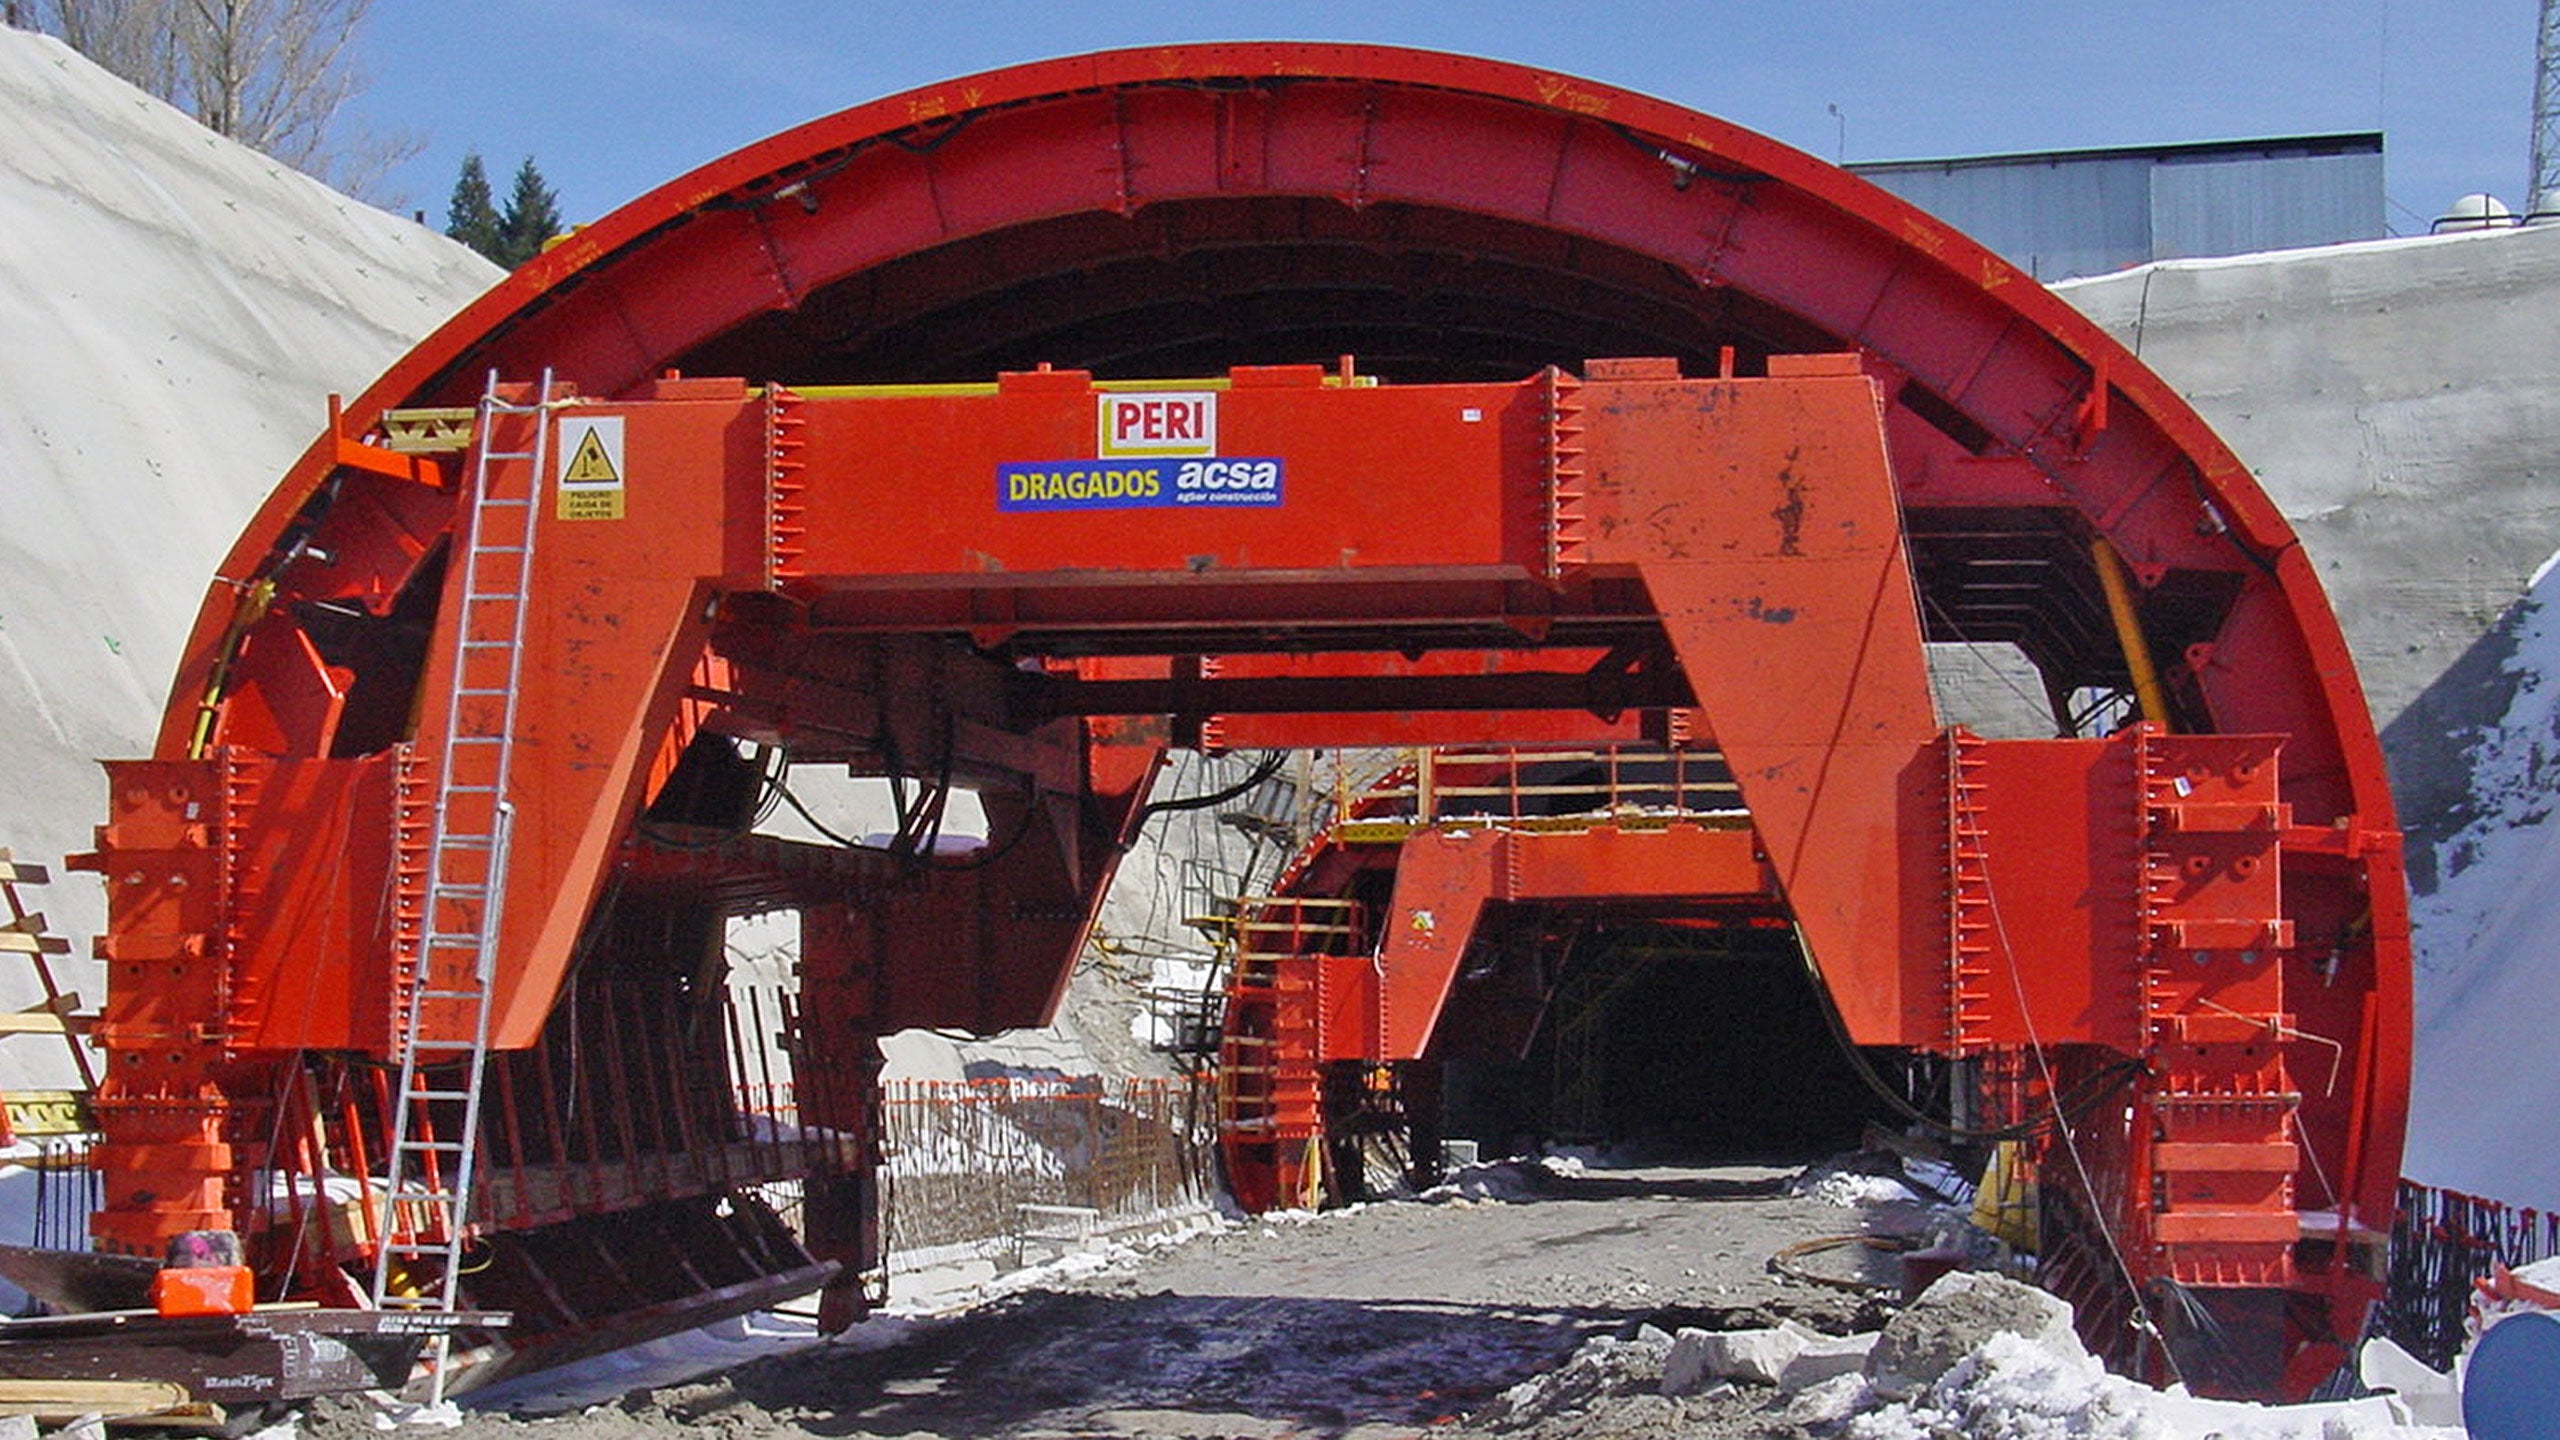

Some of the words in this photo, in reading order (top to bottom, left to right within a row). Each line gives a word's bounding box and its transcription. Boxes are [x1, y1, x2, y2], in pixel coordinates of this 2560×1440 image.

[1118, 402, 1203, 439] PERI
[1009, 470, 1160, 501] DRAGADOS
[1177, 462, 1277, 489] acsa
